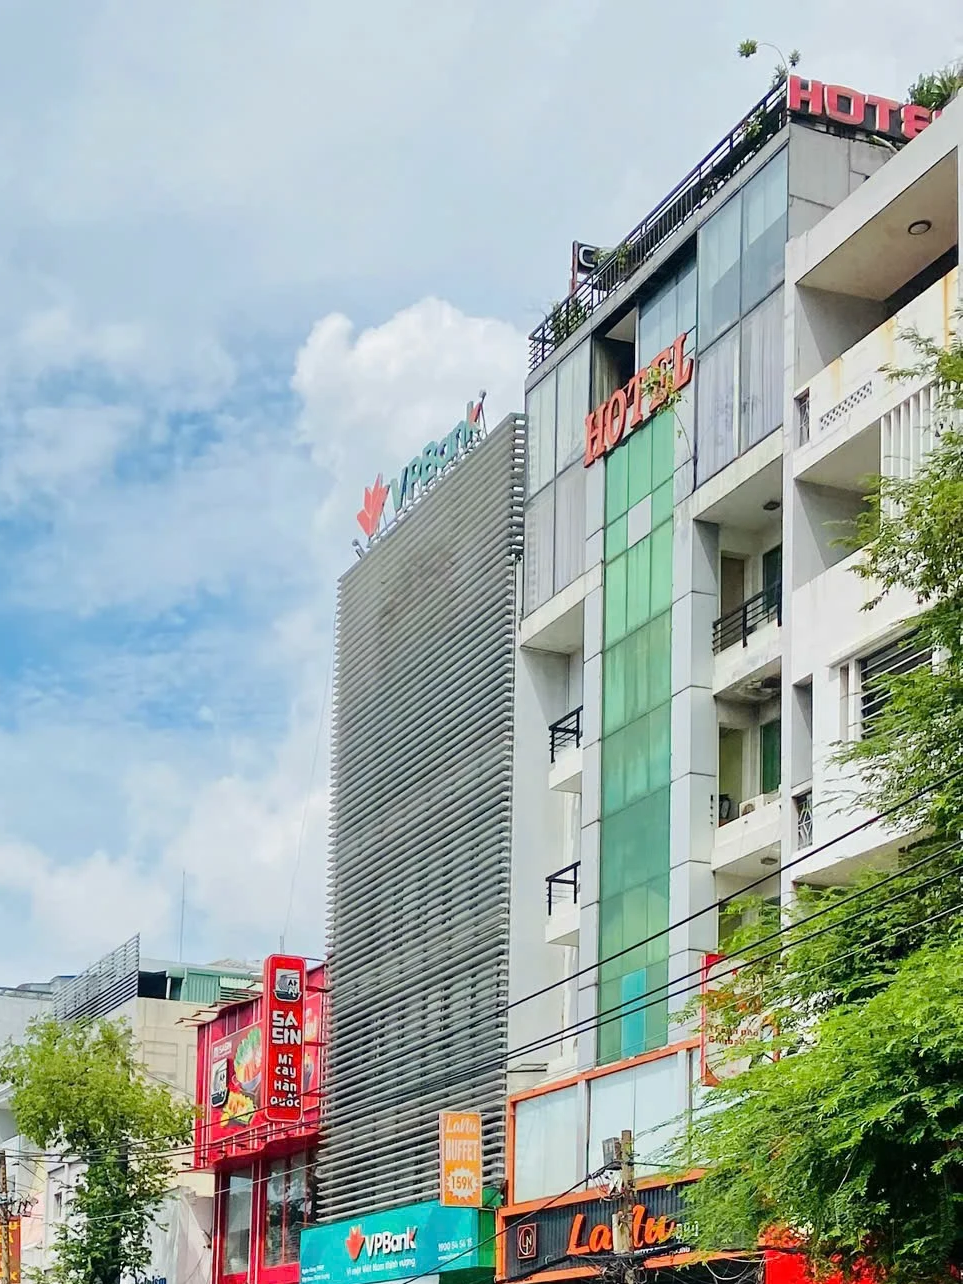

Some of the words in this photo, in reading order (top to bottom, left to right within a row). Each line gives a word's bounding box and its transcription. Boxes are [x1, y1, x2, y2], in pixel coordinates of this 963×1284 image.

[789, 74, 942, 139] HOTE
[389, 400, 482, 512] VPBank
[272, 1010, 297, 1027] SA
[272, 1028, 301, 1045] SIN
[278, 1053, 292, 1065] Mì
[275, 1066, 296, 1078] cay
[274, 1079, 296, 1092] Hàn
[446, 1139, 478, 1161] BUFFET
[452, 1176, 473, 1189] 159K
[364, 1226, 418, 1257] VPBank
